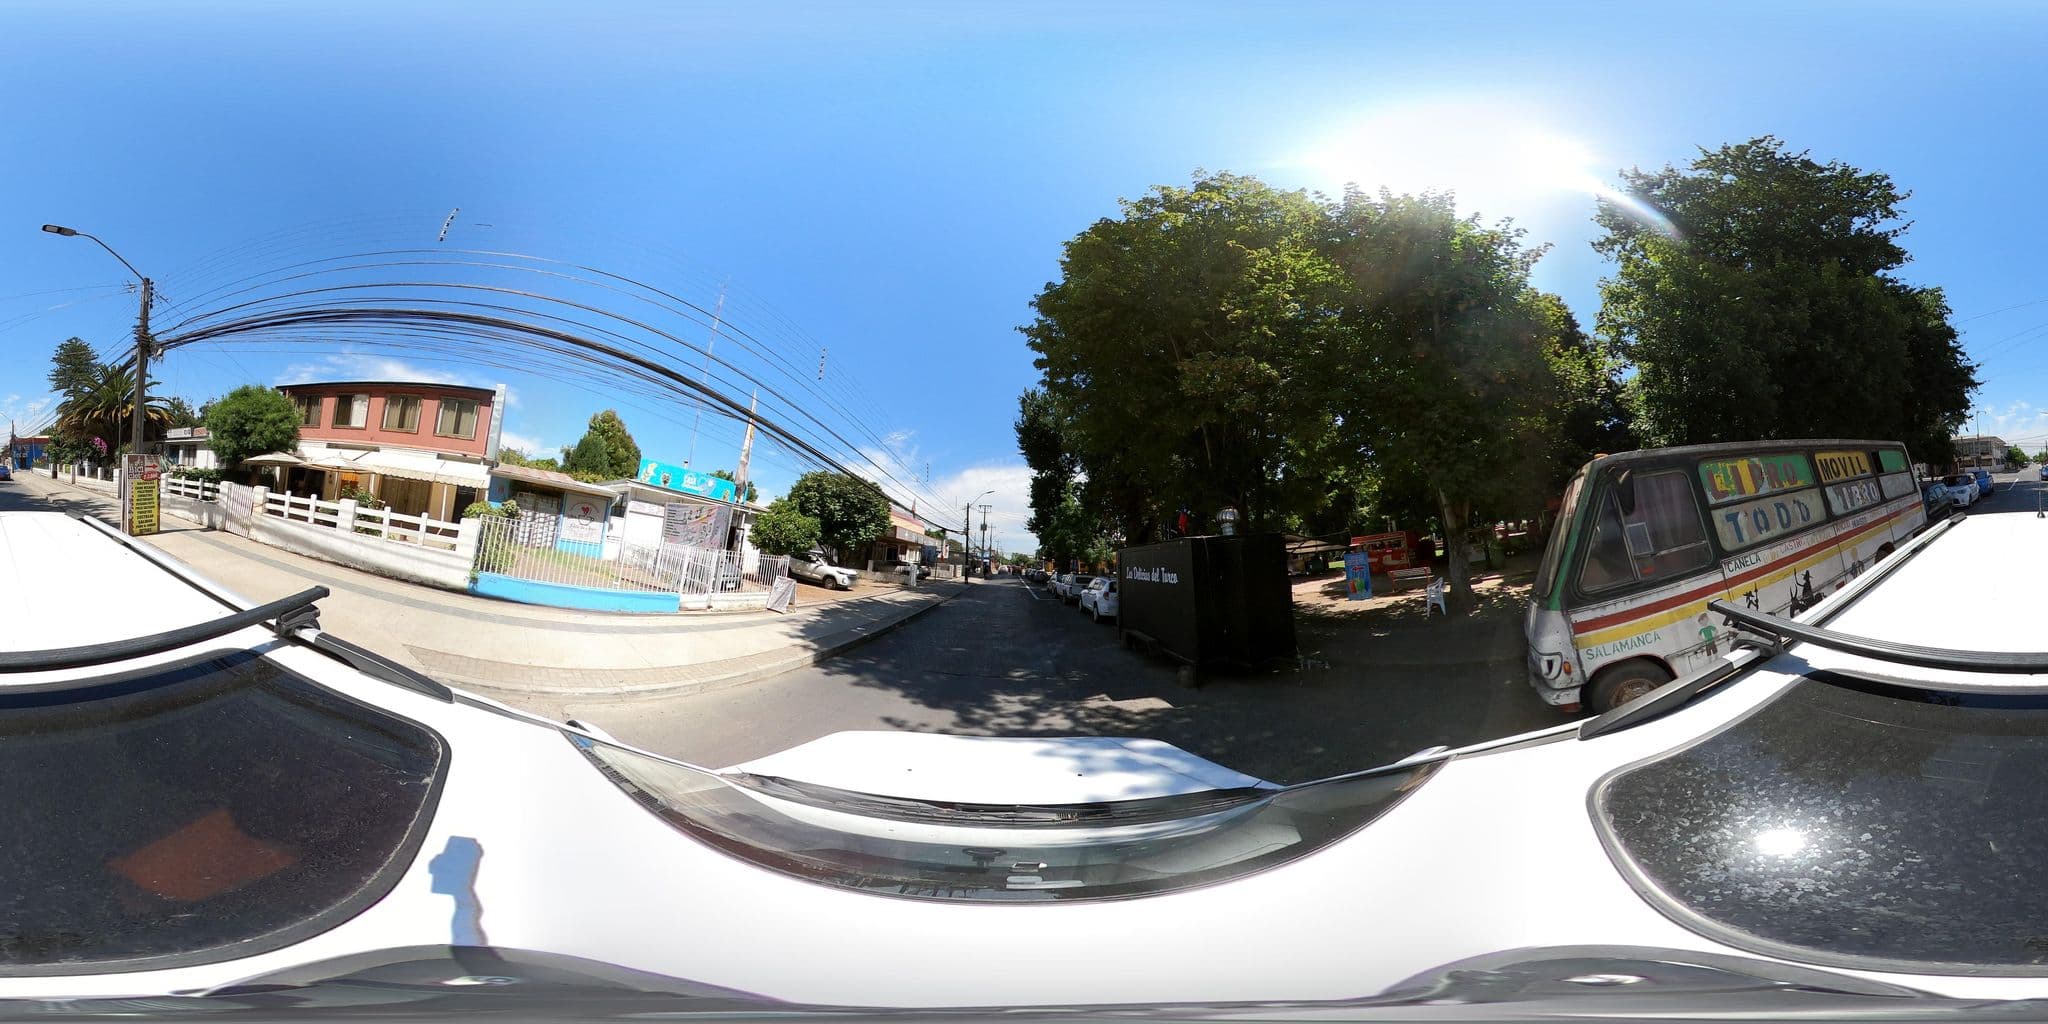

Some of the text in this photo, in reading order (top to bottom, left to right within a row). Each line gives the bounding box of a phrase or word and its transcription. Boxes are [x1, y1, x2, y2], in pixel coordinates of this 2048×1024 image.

[1819, 456, 1868, 481] MOVIL
[1727, 553, 1762, 573] CANELA
[1151, 567, 1160, 583] del
[1160, 567, 1178, 584] Turco
[1585, 631, 1662, 661] SALAMANCA
